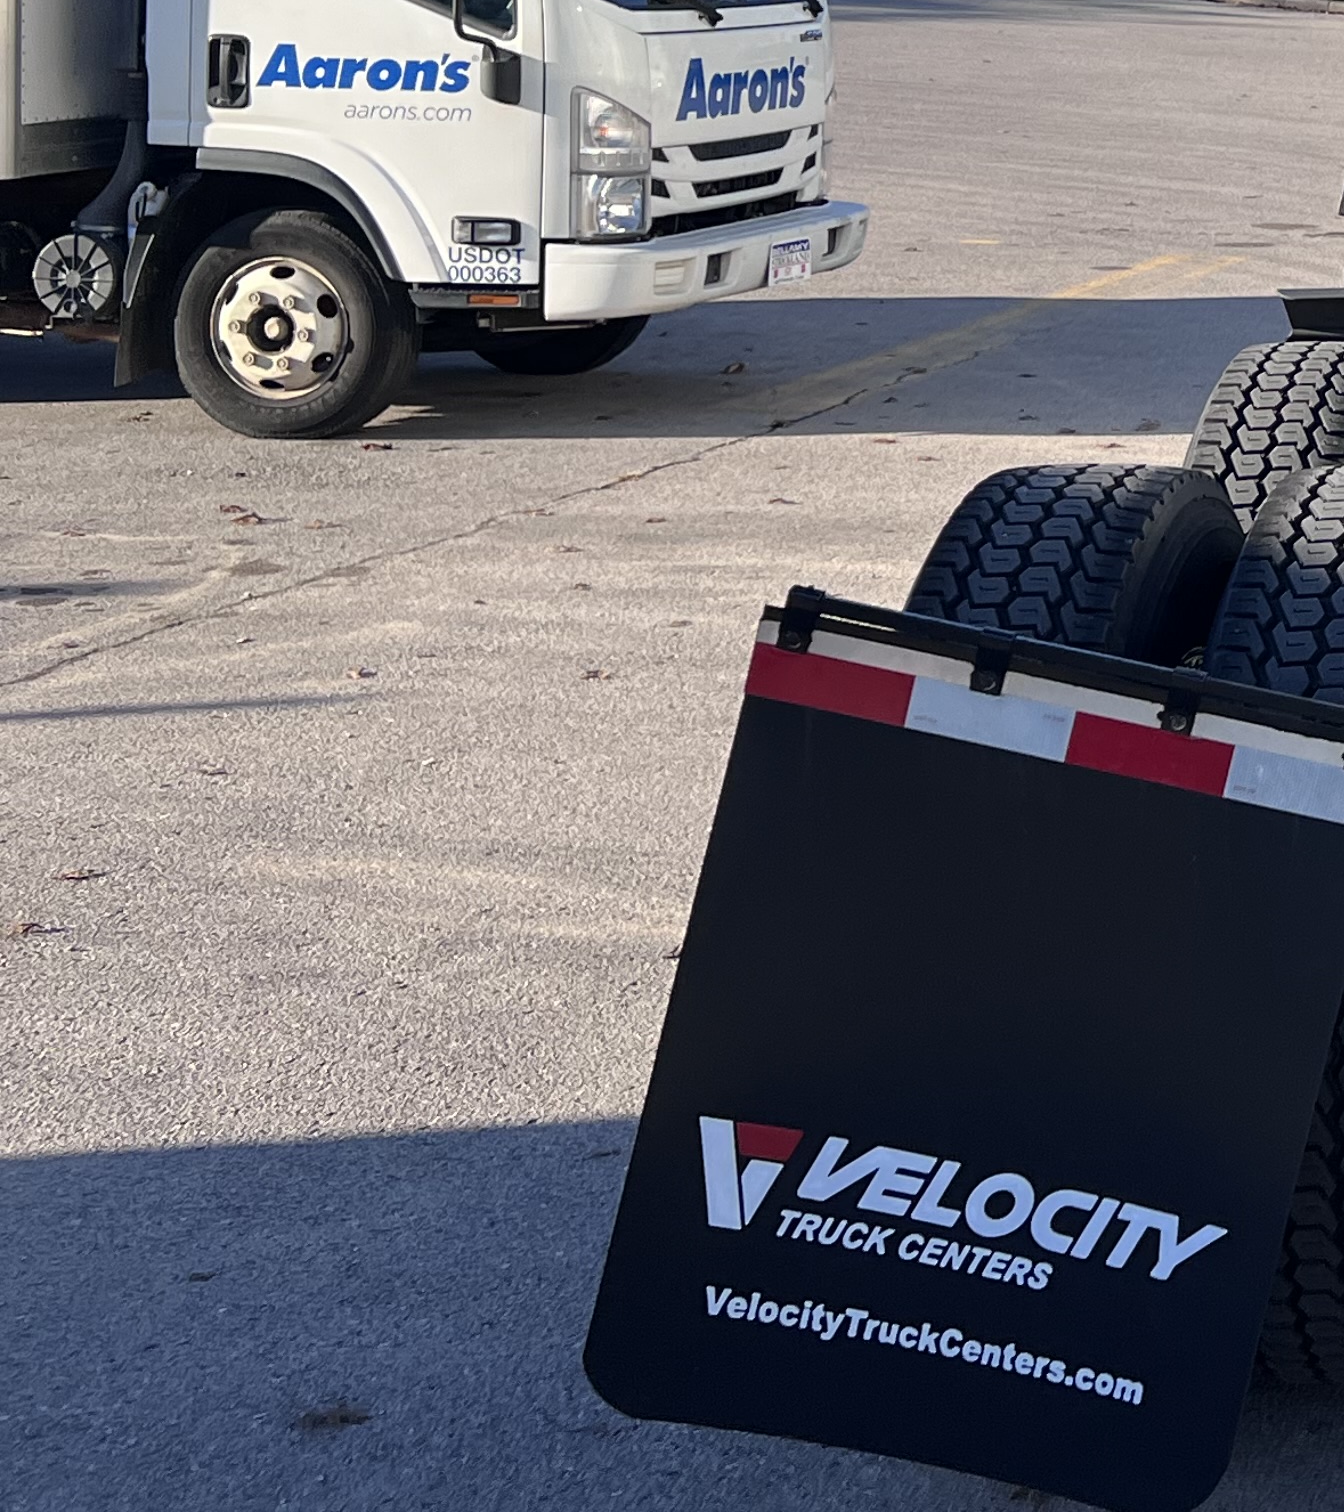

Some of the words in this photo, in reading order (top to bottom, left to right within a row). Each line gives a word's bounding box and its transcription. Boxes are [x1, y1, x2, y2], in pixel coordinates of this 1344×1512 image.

[256, 44, 471, 93] Aaron's
[676, 56, 805, 121] Aaron's
[344, 104, 472, 122] aarons.com
[448, 247, 525, 264] USDOT
[448, 266, 521, 283] 000363
[797, 1136, 1228, 1281] VELOCITY
[776, 1209, 895, 1256] TRUCK
[898, 1233, 1053, 1290] CENTERS
[705, 1286, 1144, 1405] VelocityTruckCenters.com
